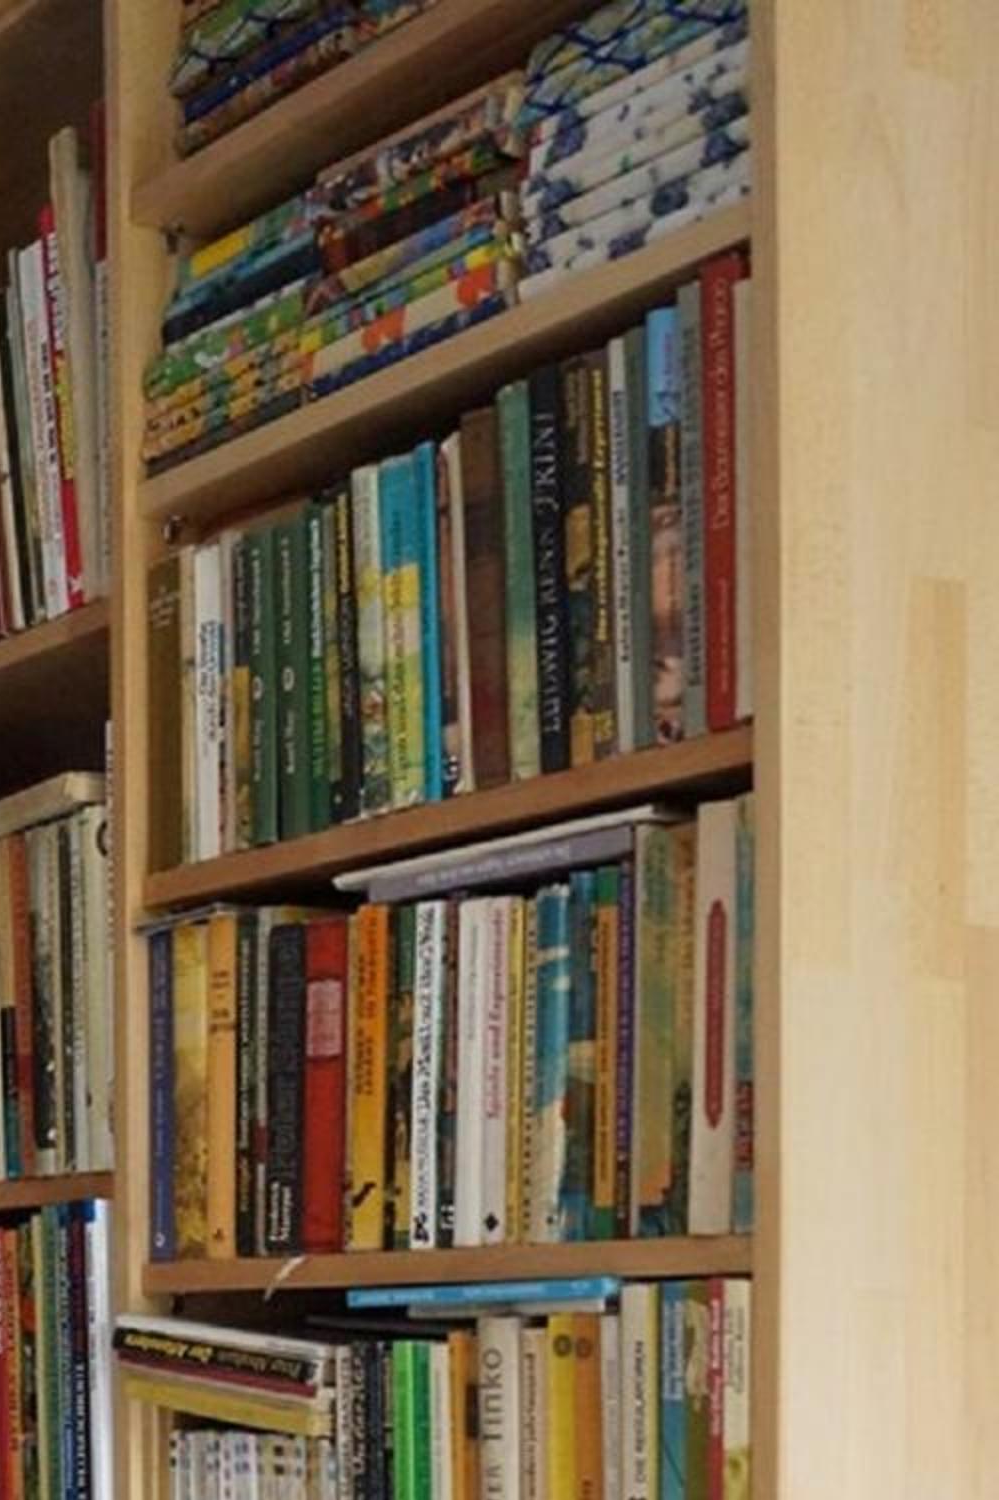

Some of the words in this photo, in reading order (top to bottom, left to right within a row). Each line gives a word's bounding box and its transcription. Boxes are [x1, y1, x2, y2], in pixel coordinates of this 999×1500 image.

[537, 523, 556, 604] RENN
[537, 613, 562, 734] LUDWIG
[481, 1348, 505, 1444] Tinko
[632, 1340, 645, 1454] REGULATOREN
